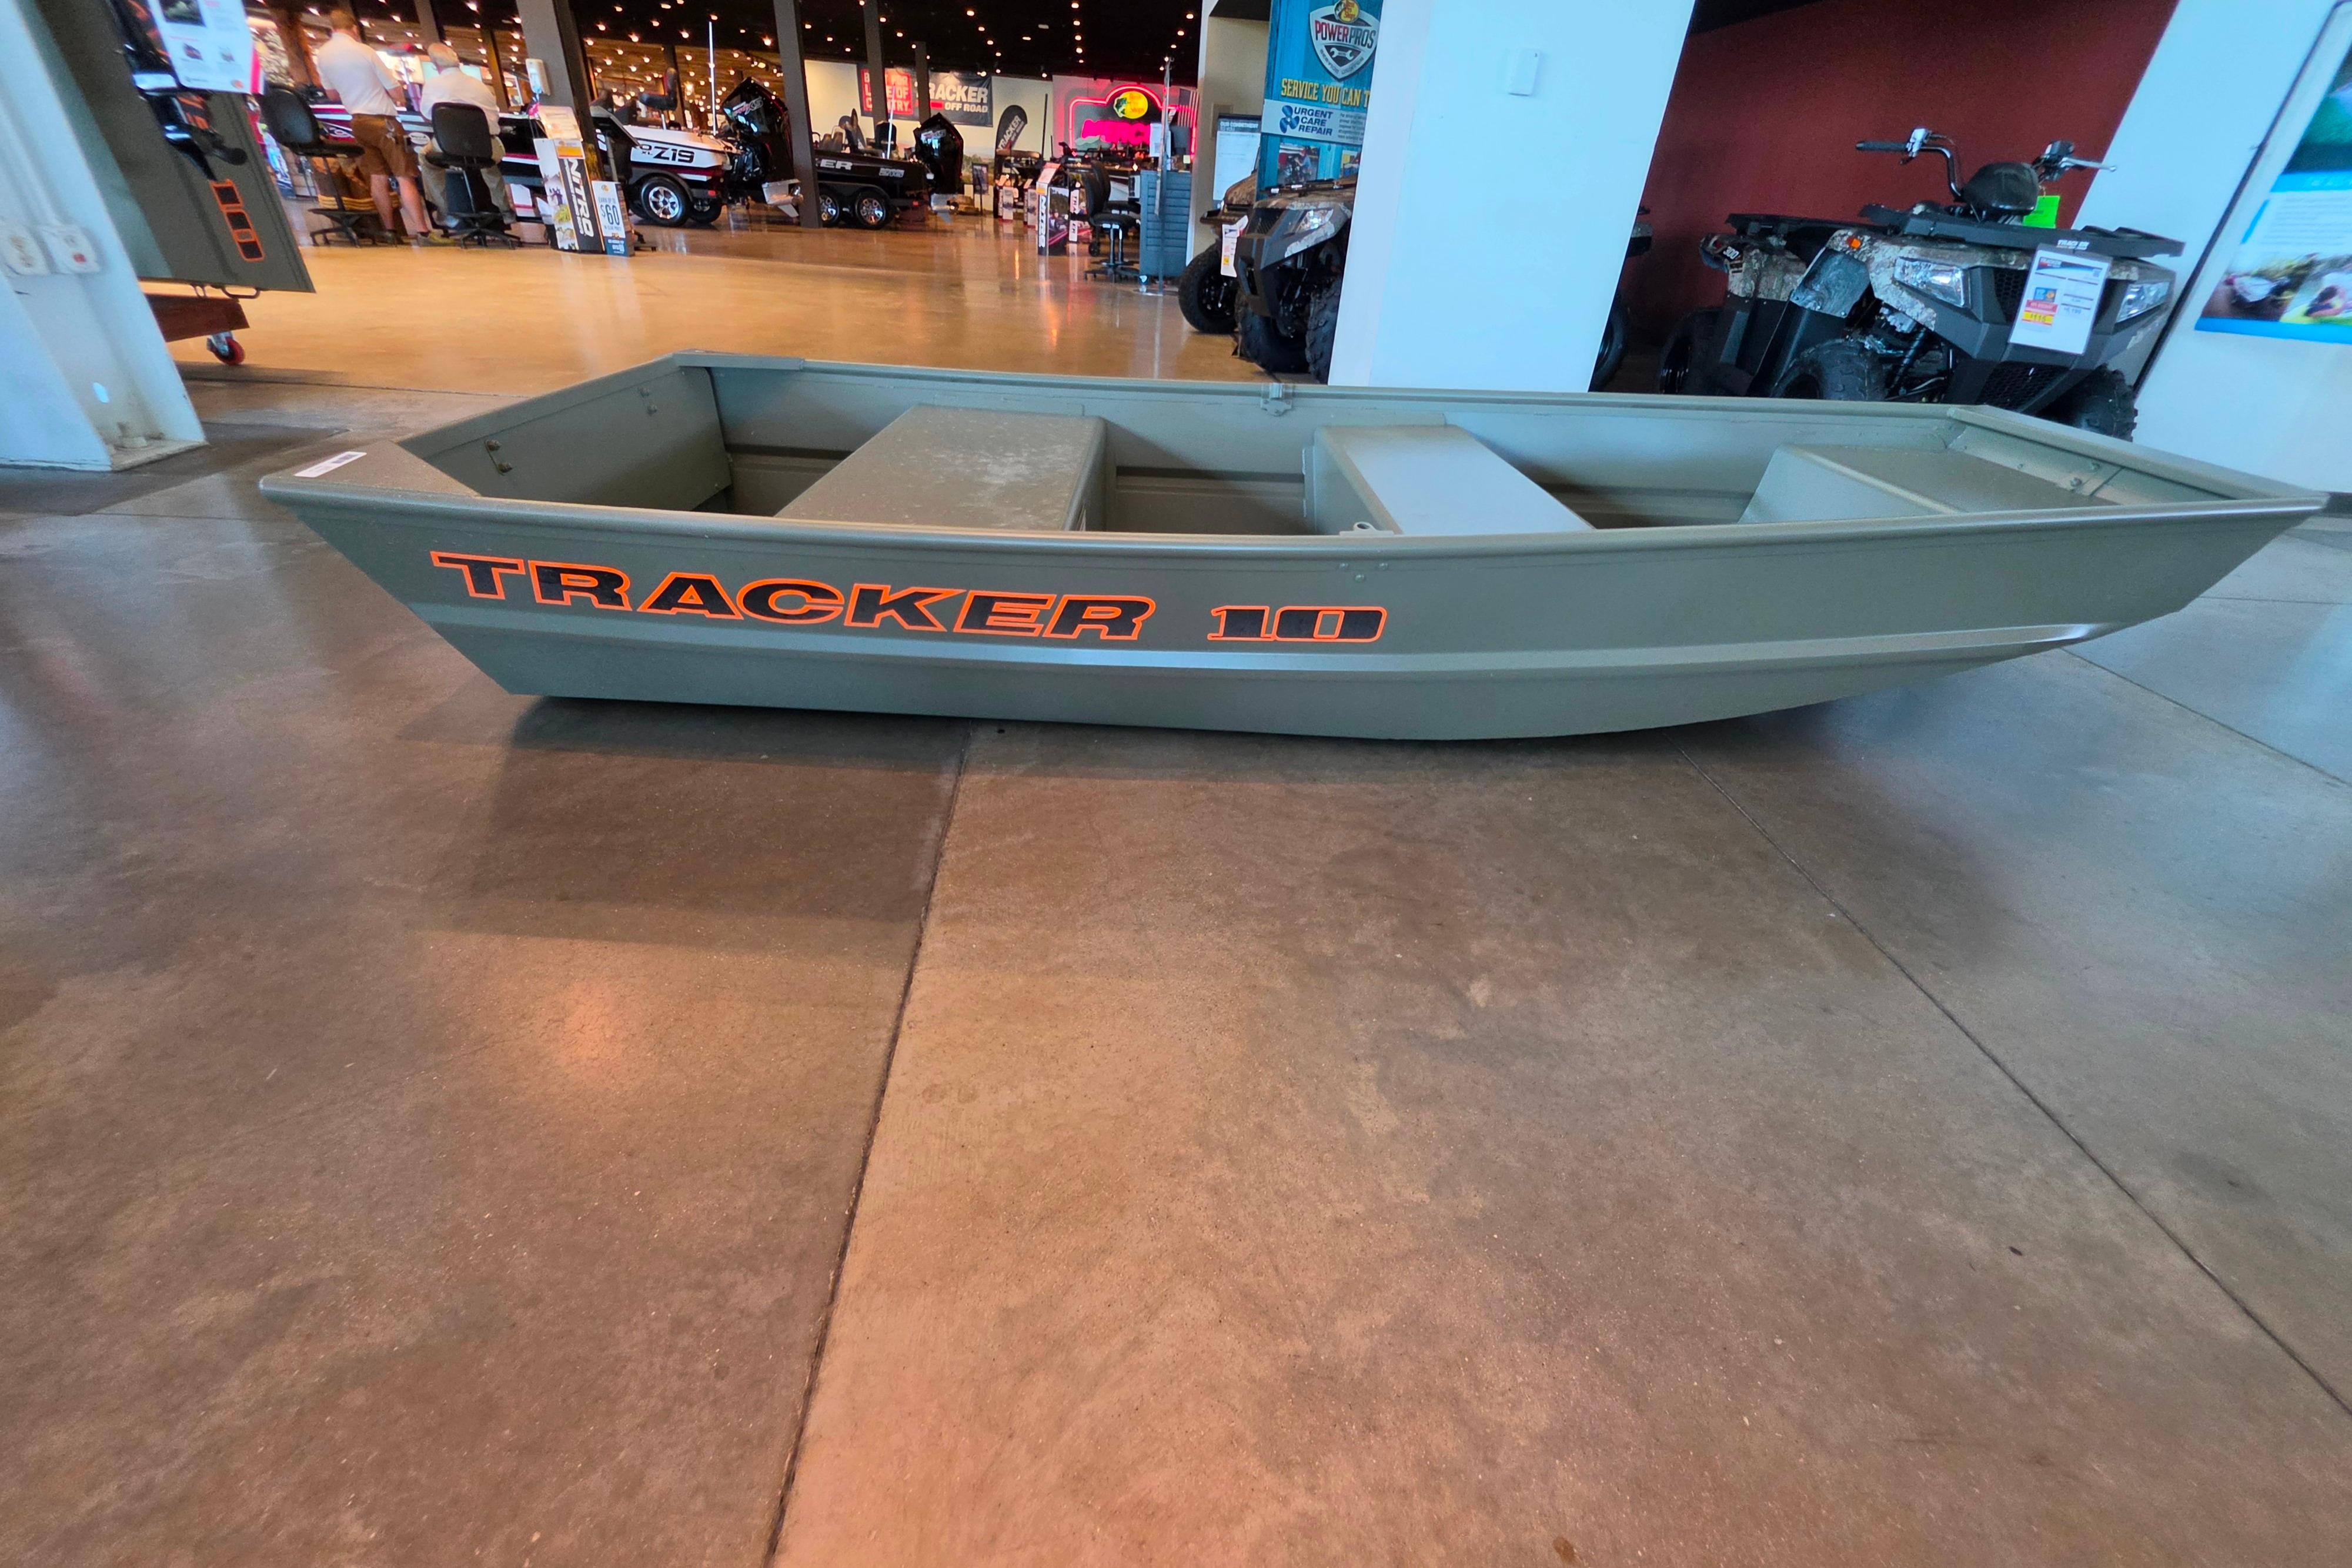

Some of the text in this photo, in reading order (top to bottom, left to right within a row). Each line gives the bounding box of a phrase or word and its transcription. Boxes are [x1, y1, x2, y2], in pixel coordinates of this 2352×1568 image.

[915, 82, 988, 103] RACKER
[1281, 78, 1319, 101] SERVICE
[1322, 84, 1341, 103] YOU
[1342, 87, 1361, 106] CAN
[944, 102, 988, 113] OFF ROAD
[1294, 106, 1334, 119] URGENT
[1301, 116, 1327, 127] CARE
[1298, 125, 1333, 136] REPAIR
[567, 158, 594, 238] NITRO
[430, 550, 1388, 643] TRACKER 10
